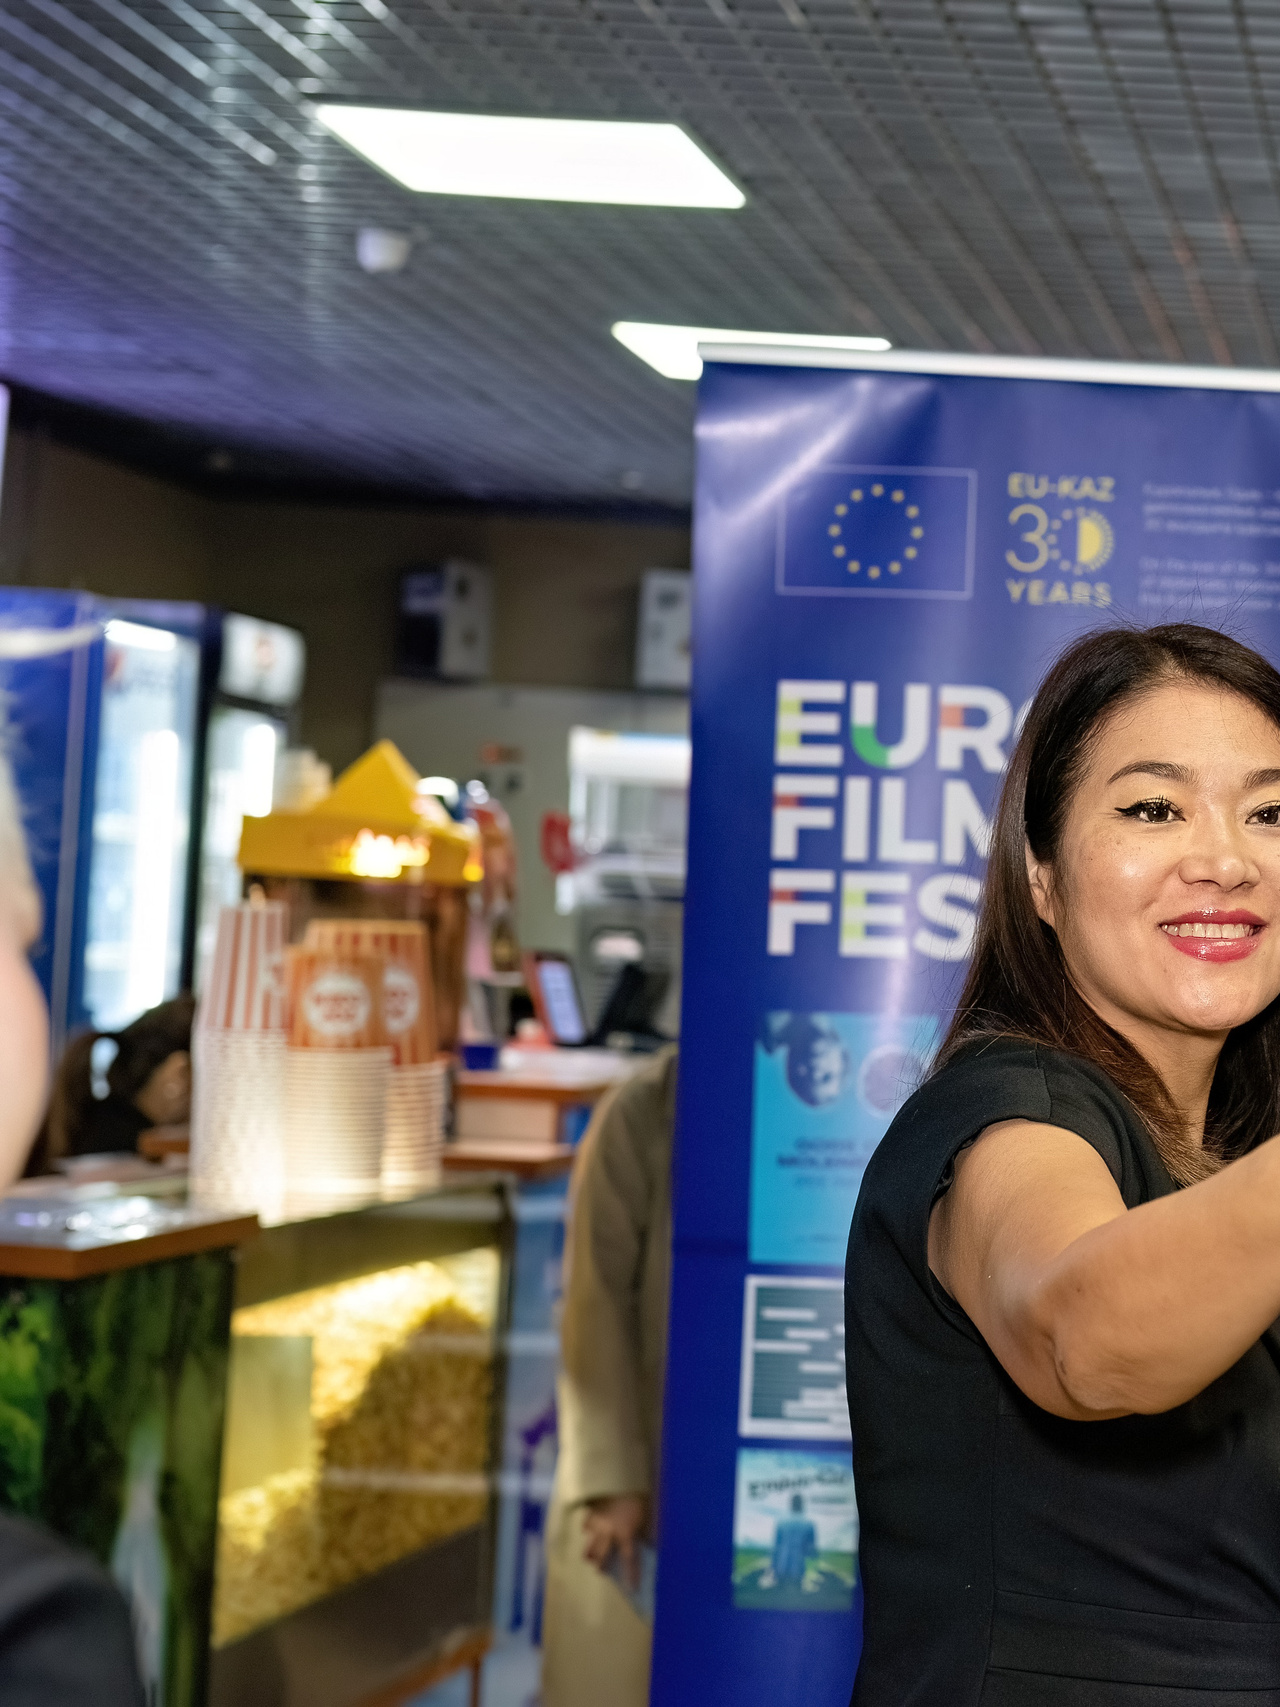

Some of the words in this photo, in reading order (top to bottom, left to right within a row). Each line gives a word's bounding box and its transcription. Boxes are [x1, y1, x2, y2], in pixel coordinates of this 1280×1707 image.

[1007, 472, 1115, 502] EU-KAZ
[1005, 577, 1112, 608] YEARS
[774, 679, 1034, 773] EUR
